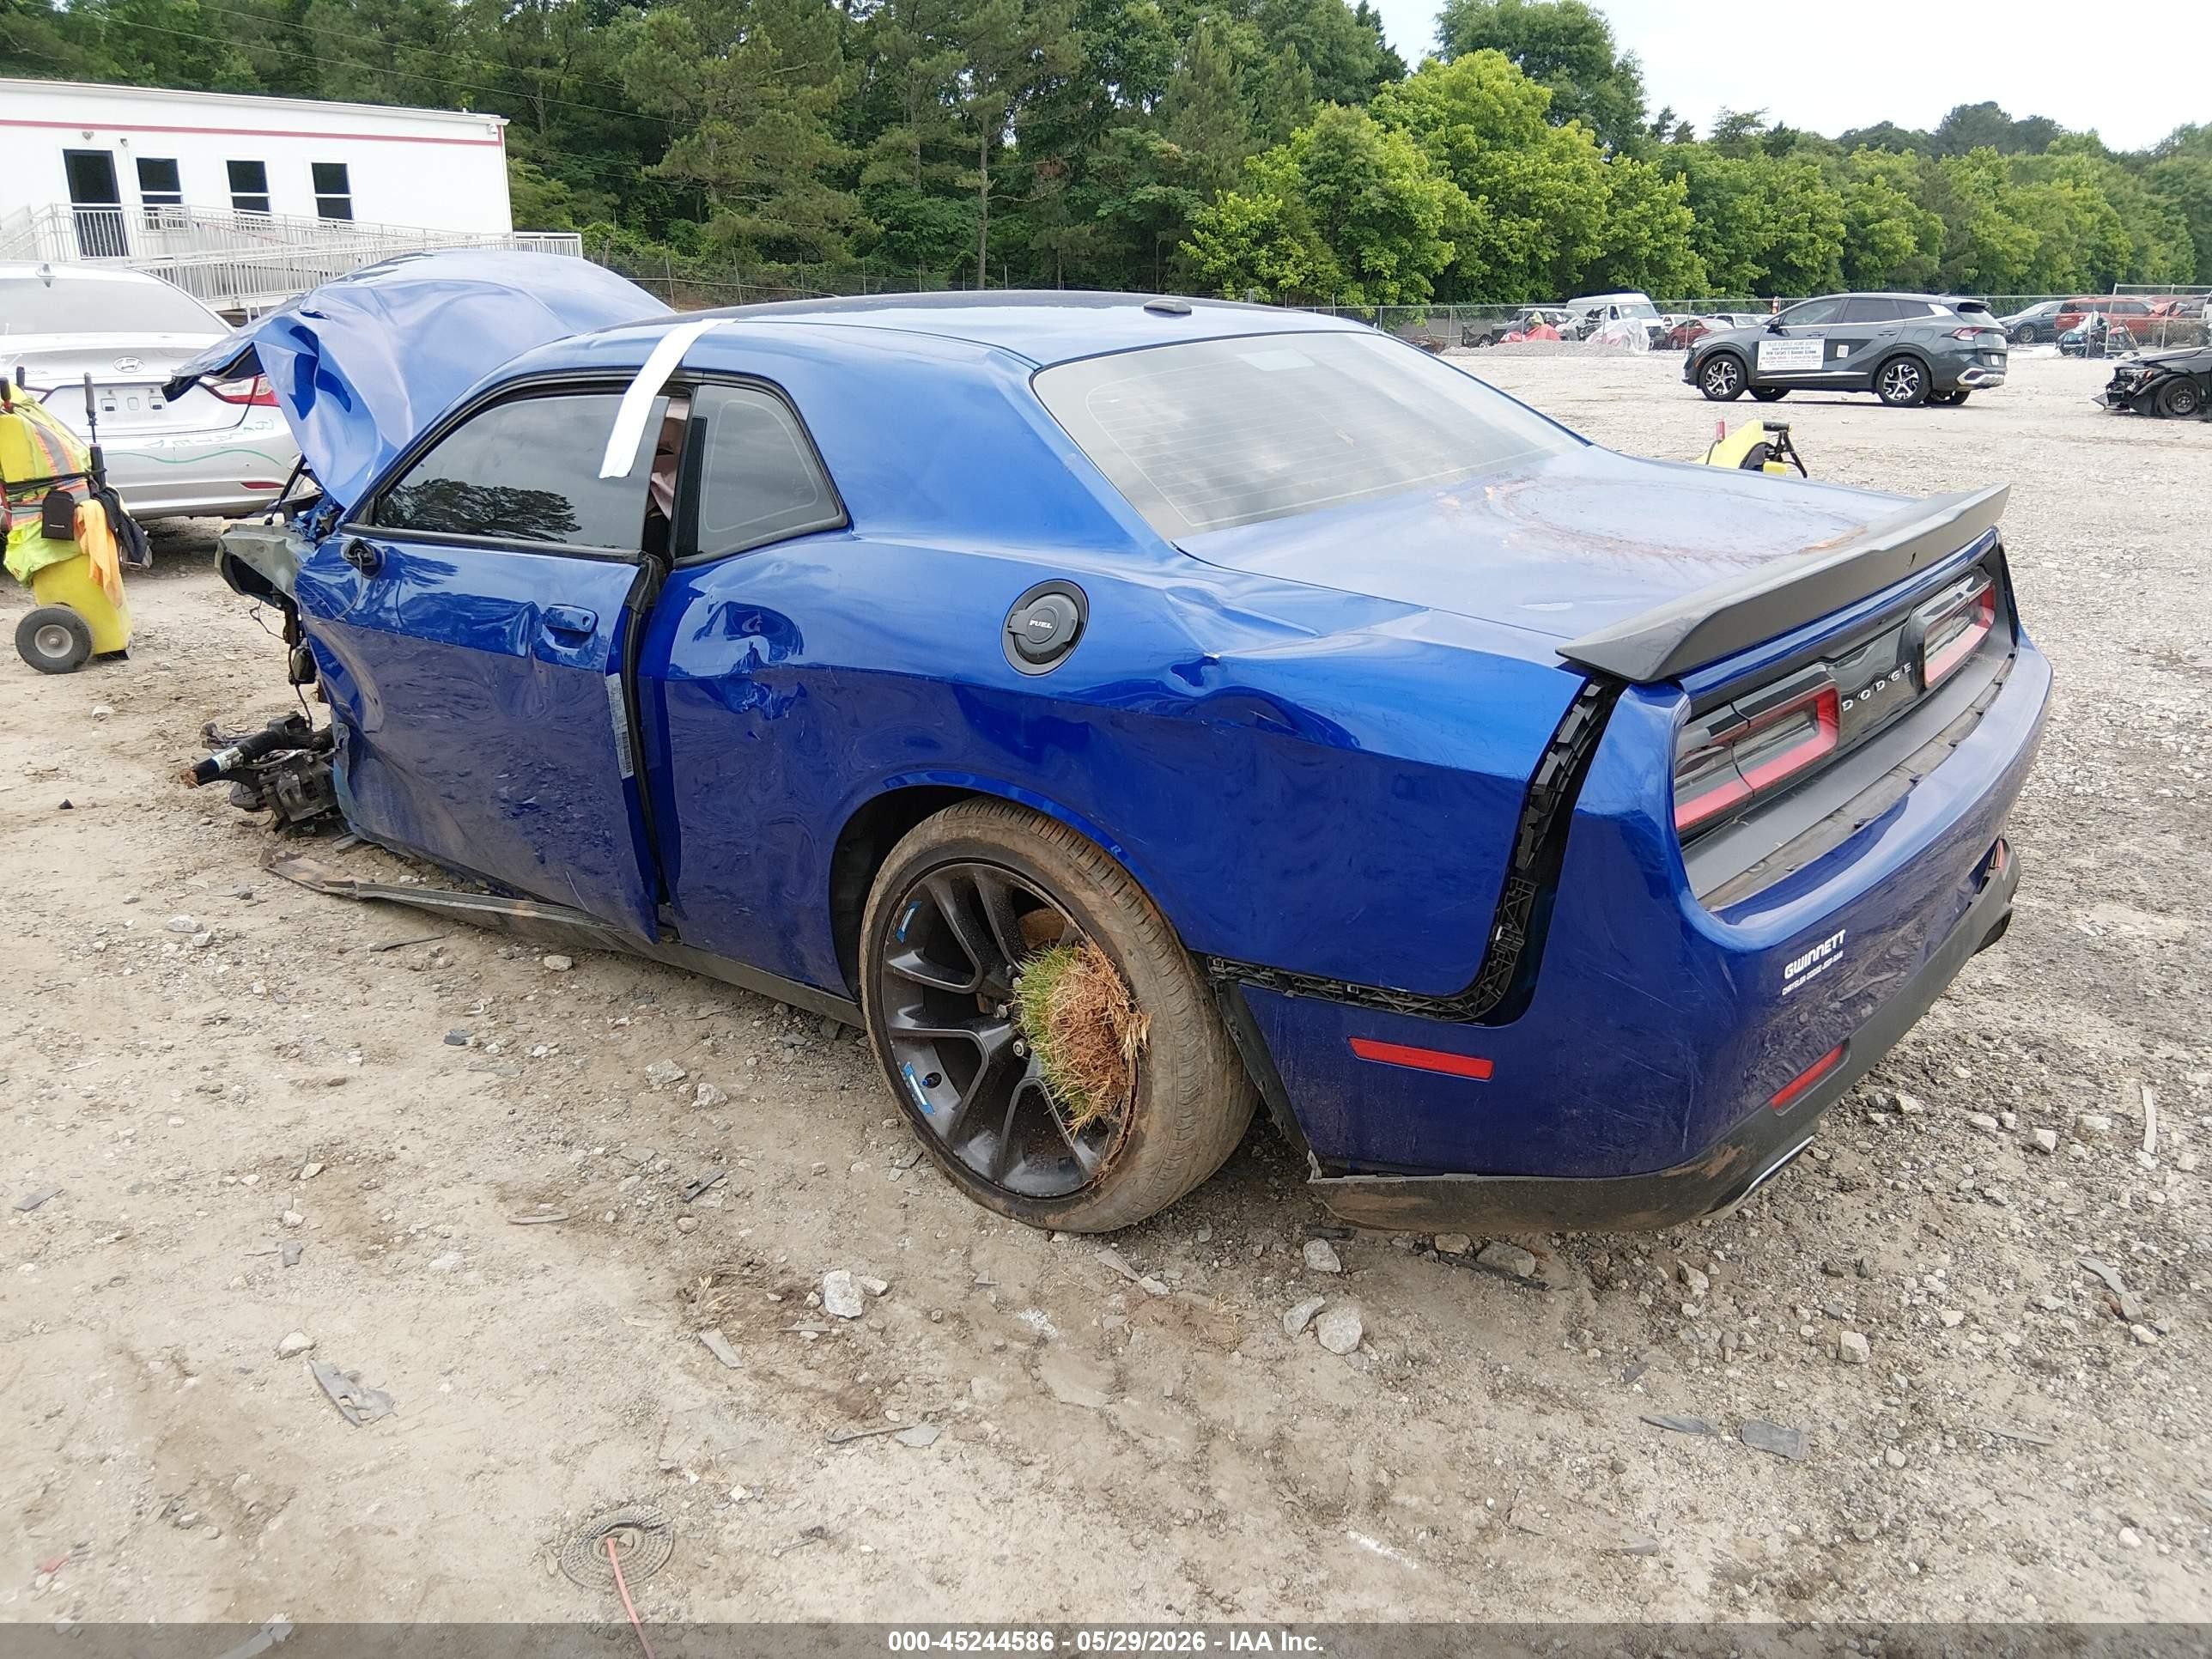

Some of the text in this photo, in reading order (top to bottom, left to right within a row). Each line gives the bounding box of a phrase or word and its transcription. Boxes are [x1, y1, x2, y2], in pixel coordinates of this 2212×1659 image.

[1030, 620, 1053, 629] FUEL
[1842, 662, 1911, 711] DODGE
[1784, 928, 1846, 980] GWINNETT
